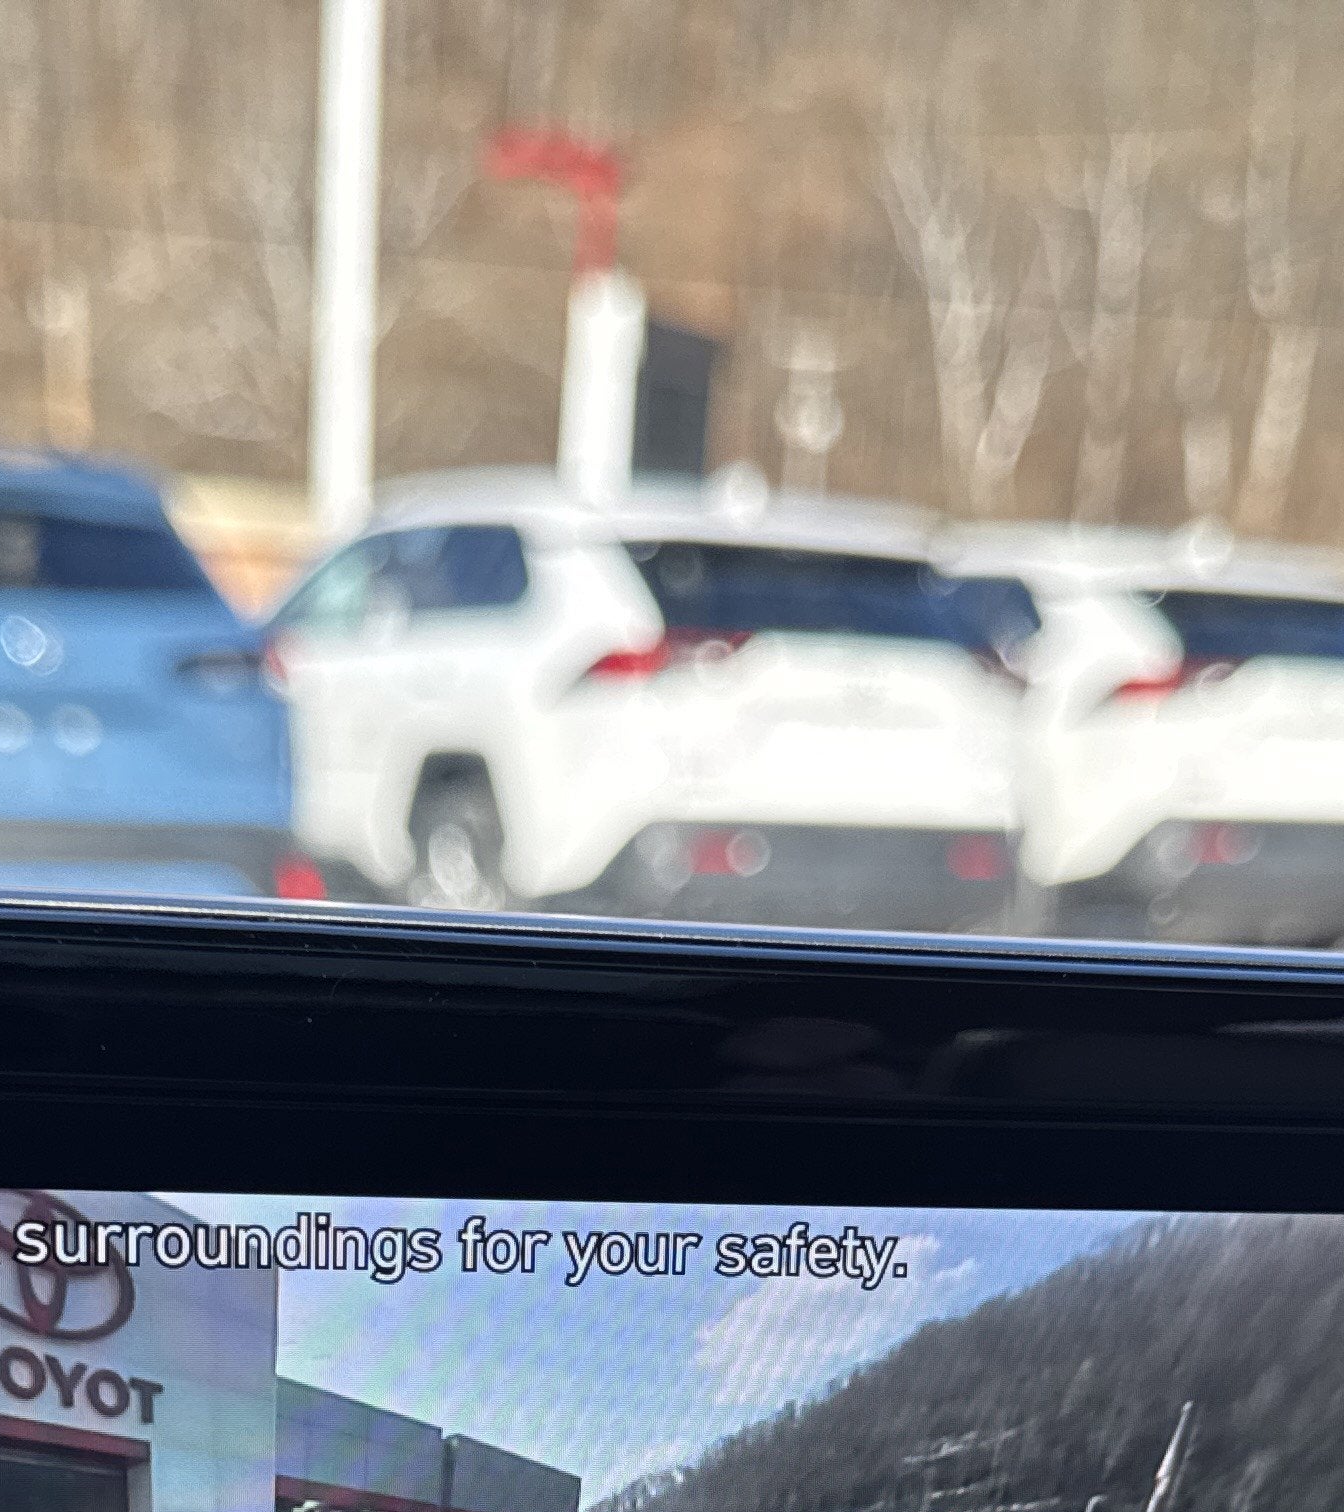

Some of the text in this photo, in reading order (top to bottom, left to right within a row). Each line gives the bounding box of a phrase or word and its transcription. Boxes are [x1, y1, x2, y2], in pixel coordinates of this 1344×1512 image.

[13, 1212, 443, 1284] surroundings
[460, 1216, 549, 1275] for
[564, 1230, 702, 1286] your
[715, 1222, 909, 1289] safety.
